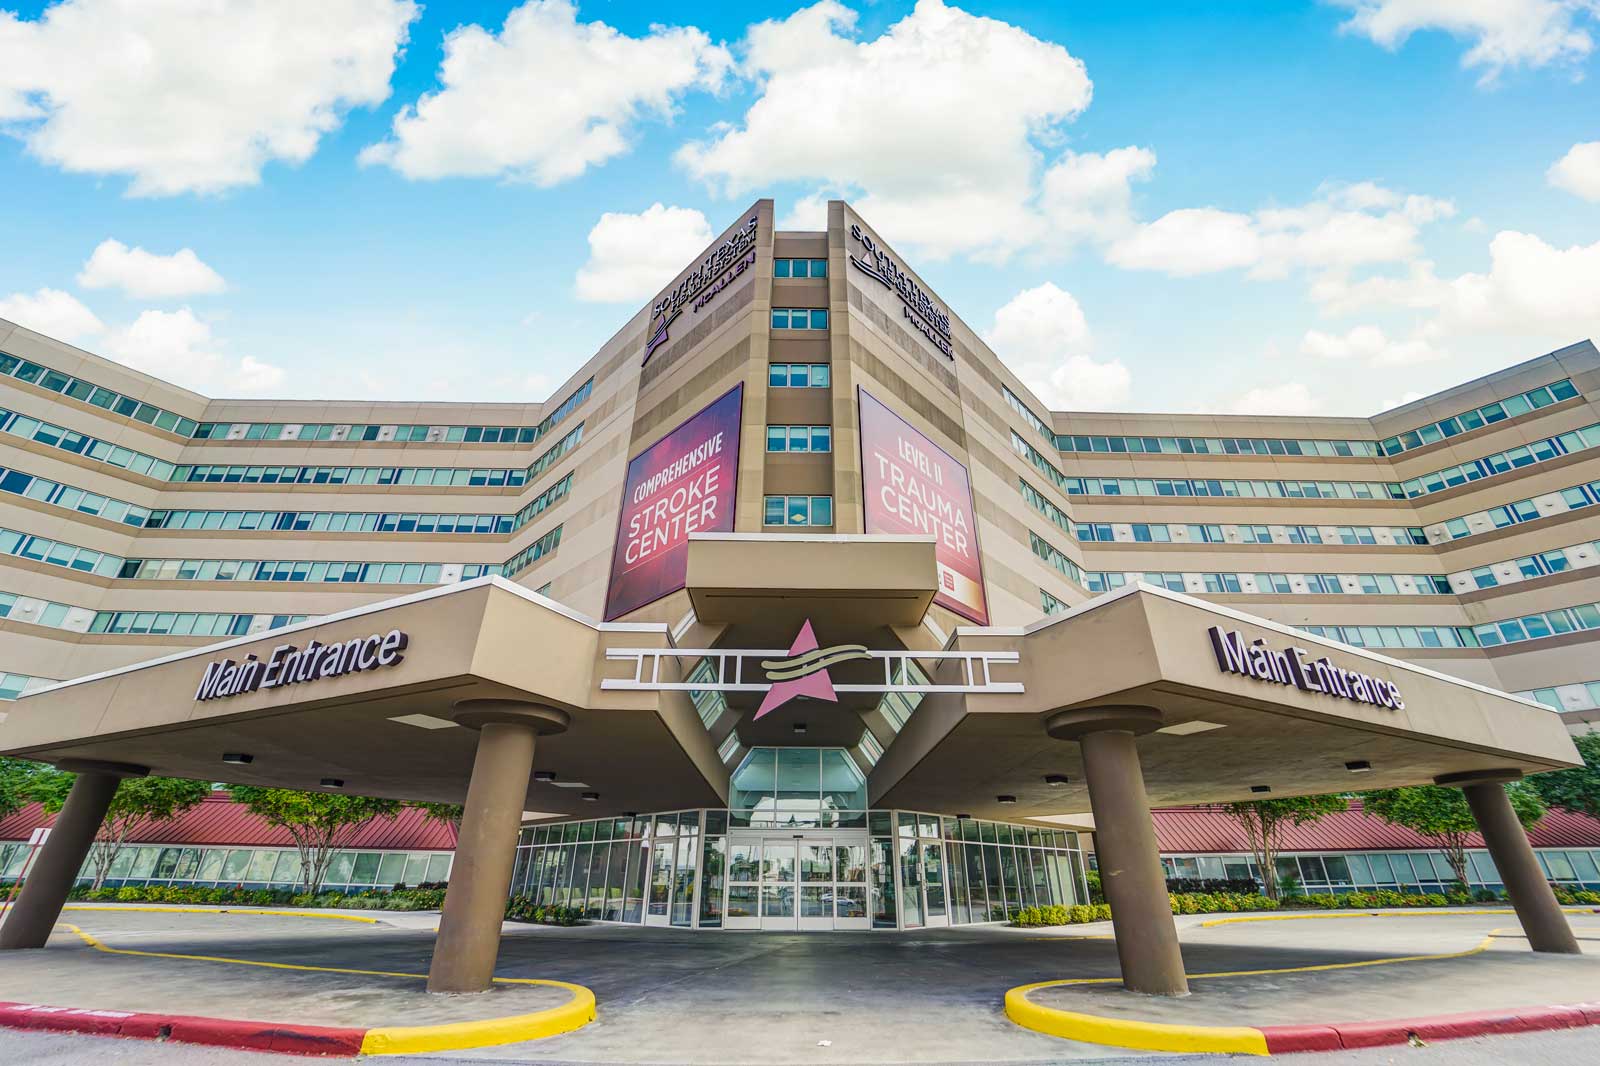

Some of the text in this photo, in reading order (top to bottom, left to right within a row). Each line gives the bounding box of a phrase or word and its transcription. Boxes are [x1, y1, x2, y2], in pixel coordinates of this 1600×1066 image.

[653, 216, 758, 320] SOUTH TEXAS
[671, 230, 757, 313] HEALTH SYSTEM
[851, 223, 951, 328] SOUTH TEXAS
[877, 260, 952, 340] HEALTH SYSTEM
[633, 432, 724, 504] COMPREHENSIVE
[874, 452, 968, 534] TRAUMA
[898, 436, 943, 486] LEVEL II
[625, 495, 718, 564] CENTER
[628, 464, 721, 538] STROKE
[881, 485, 969, 558] CENTER
[194, 629, 408, 701] Main Entrance
[1208, 624, 1405, 710] Main Entrance
